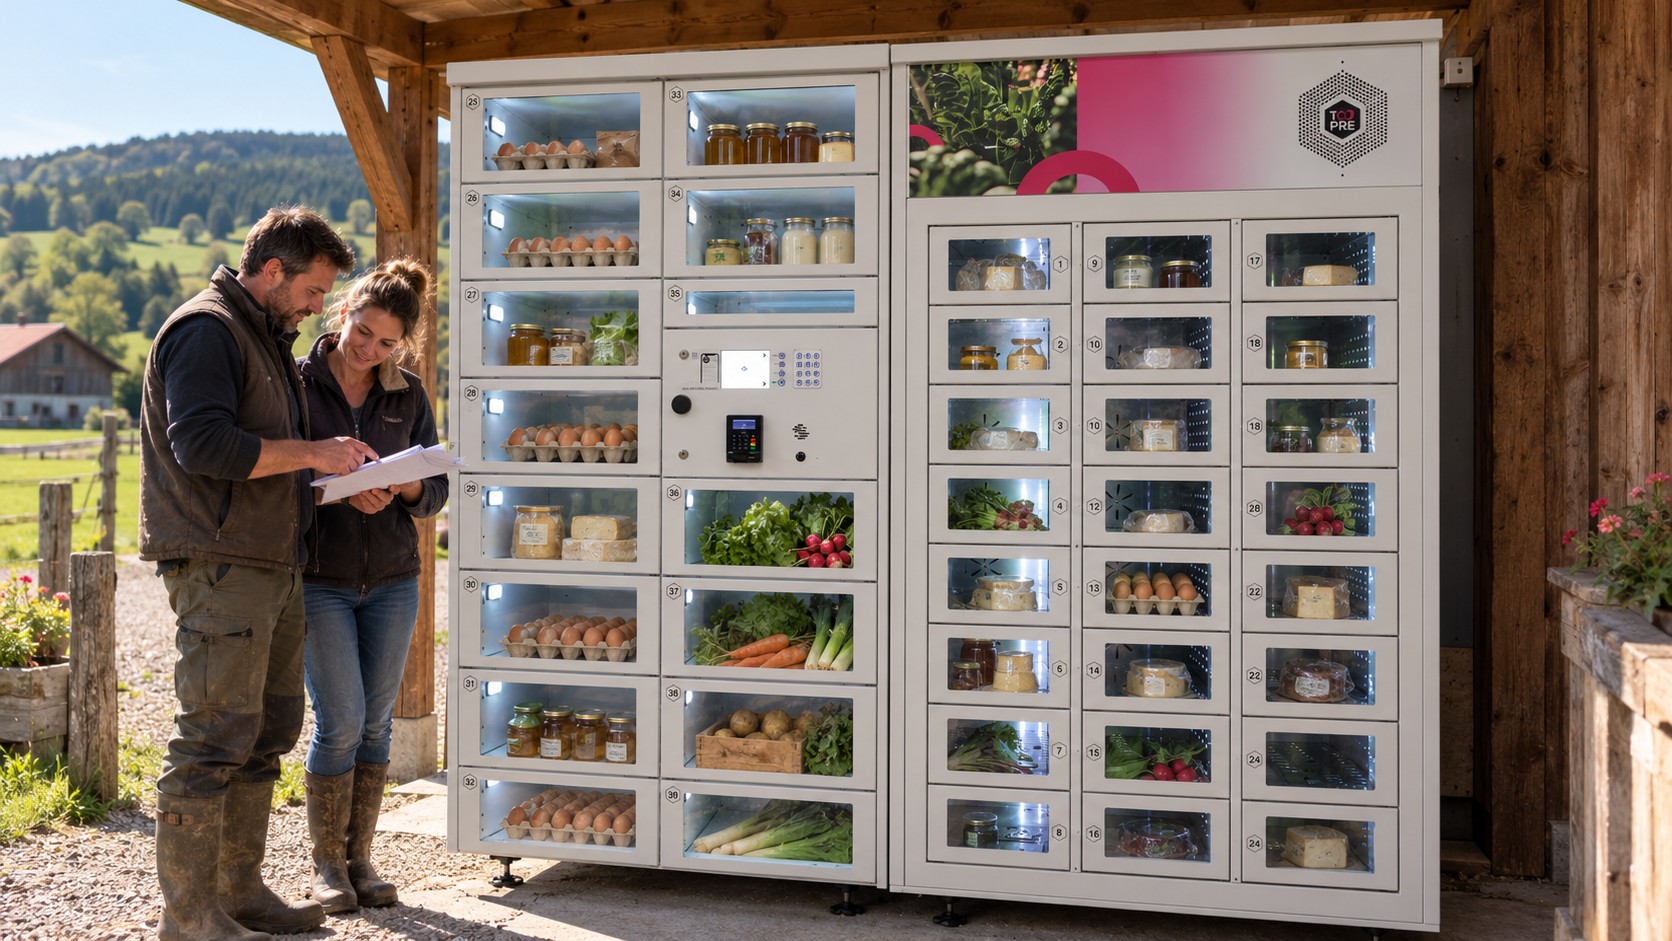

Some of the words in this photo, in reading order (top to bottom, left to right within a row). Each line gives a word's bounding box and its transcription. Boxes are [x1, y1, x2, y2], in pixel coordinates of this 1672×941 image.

[671, 90, 682, 99] 33
[1330, 121, 1355, 131] PRE
[467, 194, 477, 202] 26
[670, 189, 681, 198] 34
[1250, 256, 1261, 265] 17
[466, 290, 477, 299] 27
[1089, 340, 1101, 349] 10
[1249, 339, 1261, 347] 18
[466, 389, 477, 397] 28
[1089, 421, 1100, 430] 10
[1249, 422, 1261, 431] 18
[466, 484, 476, 493] 29
[669, 488, 680, 497] 36
[1089, 502, 1100, 511] 12
[1249, 504, 1261, 513] 28
[465, 580, 476, 589] 30
[1089, 584, 1100, 593] 13
[668, 587, 679, 595] 37
[1248, 587, 1261, 596] 22
[1089, 666, 1100, 675] 14
[1249, 671, 1261, 680] 22
[465, 679, 474, 688] 31
[1248, 755, 1261, 764] 24
[465, 777, 475, 786] 32
[1089, 830, 1100, 838] 16
[1248, 839, 1260, 848] 24
